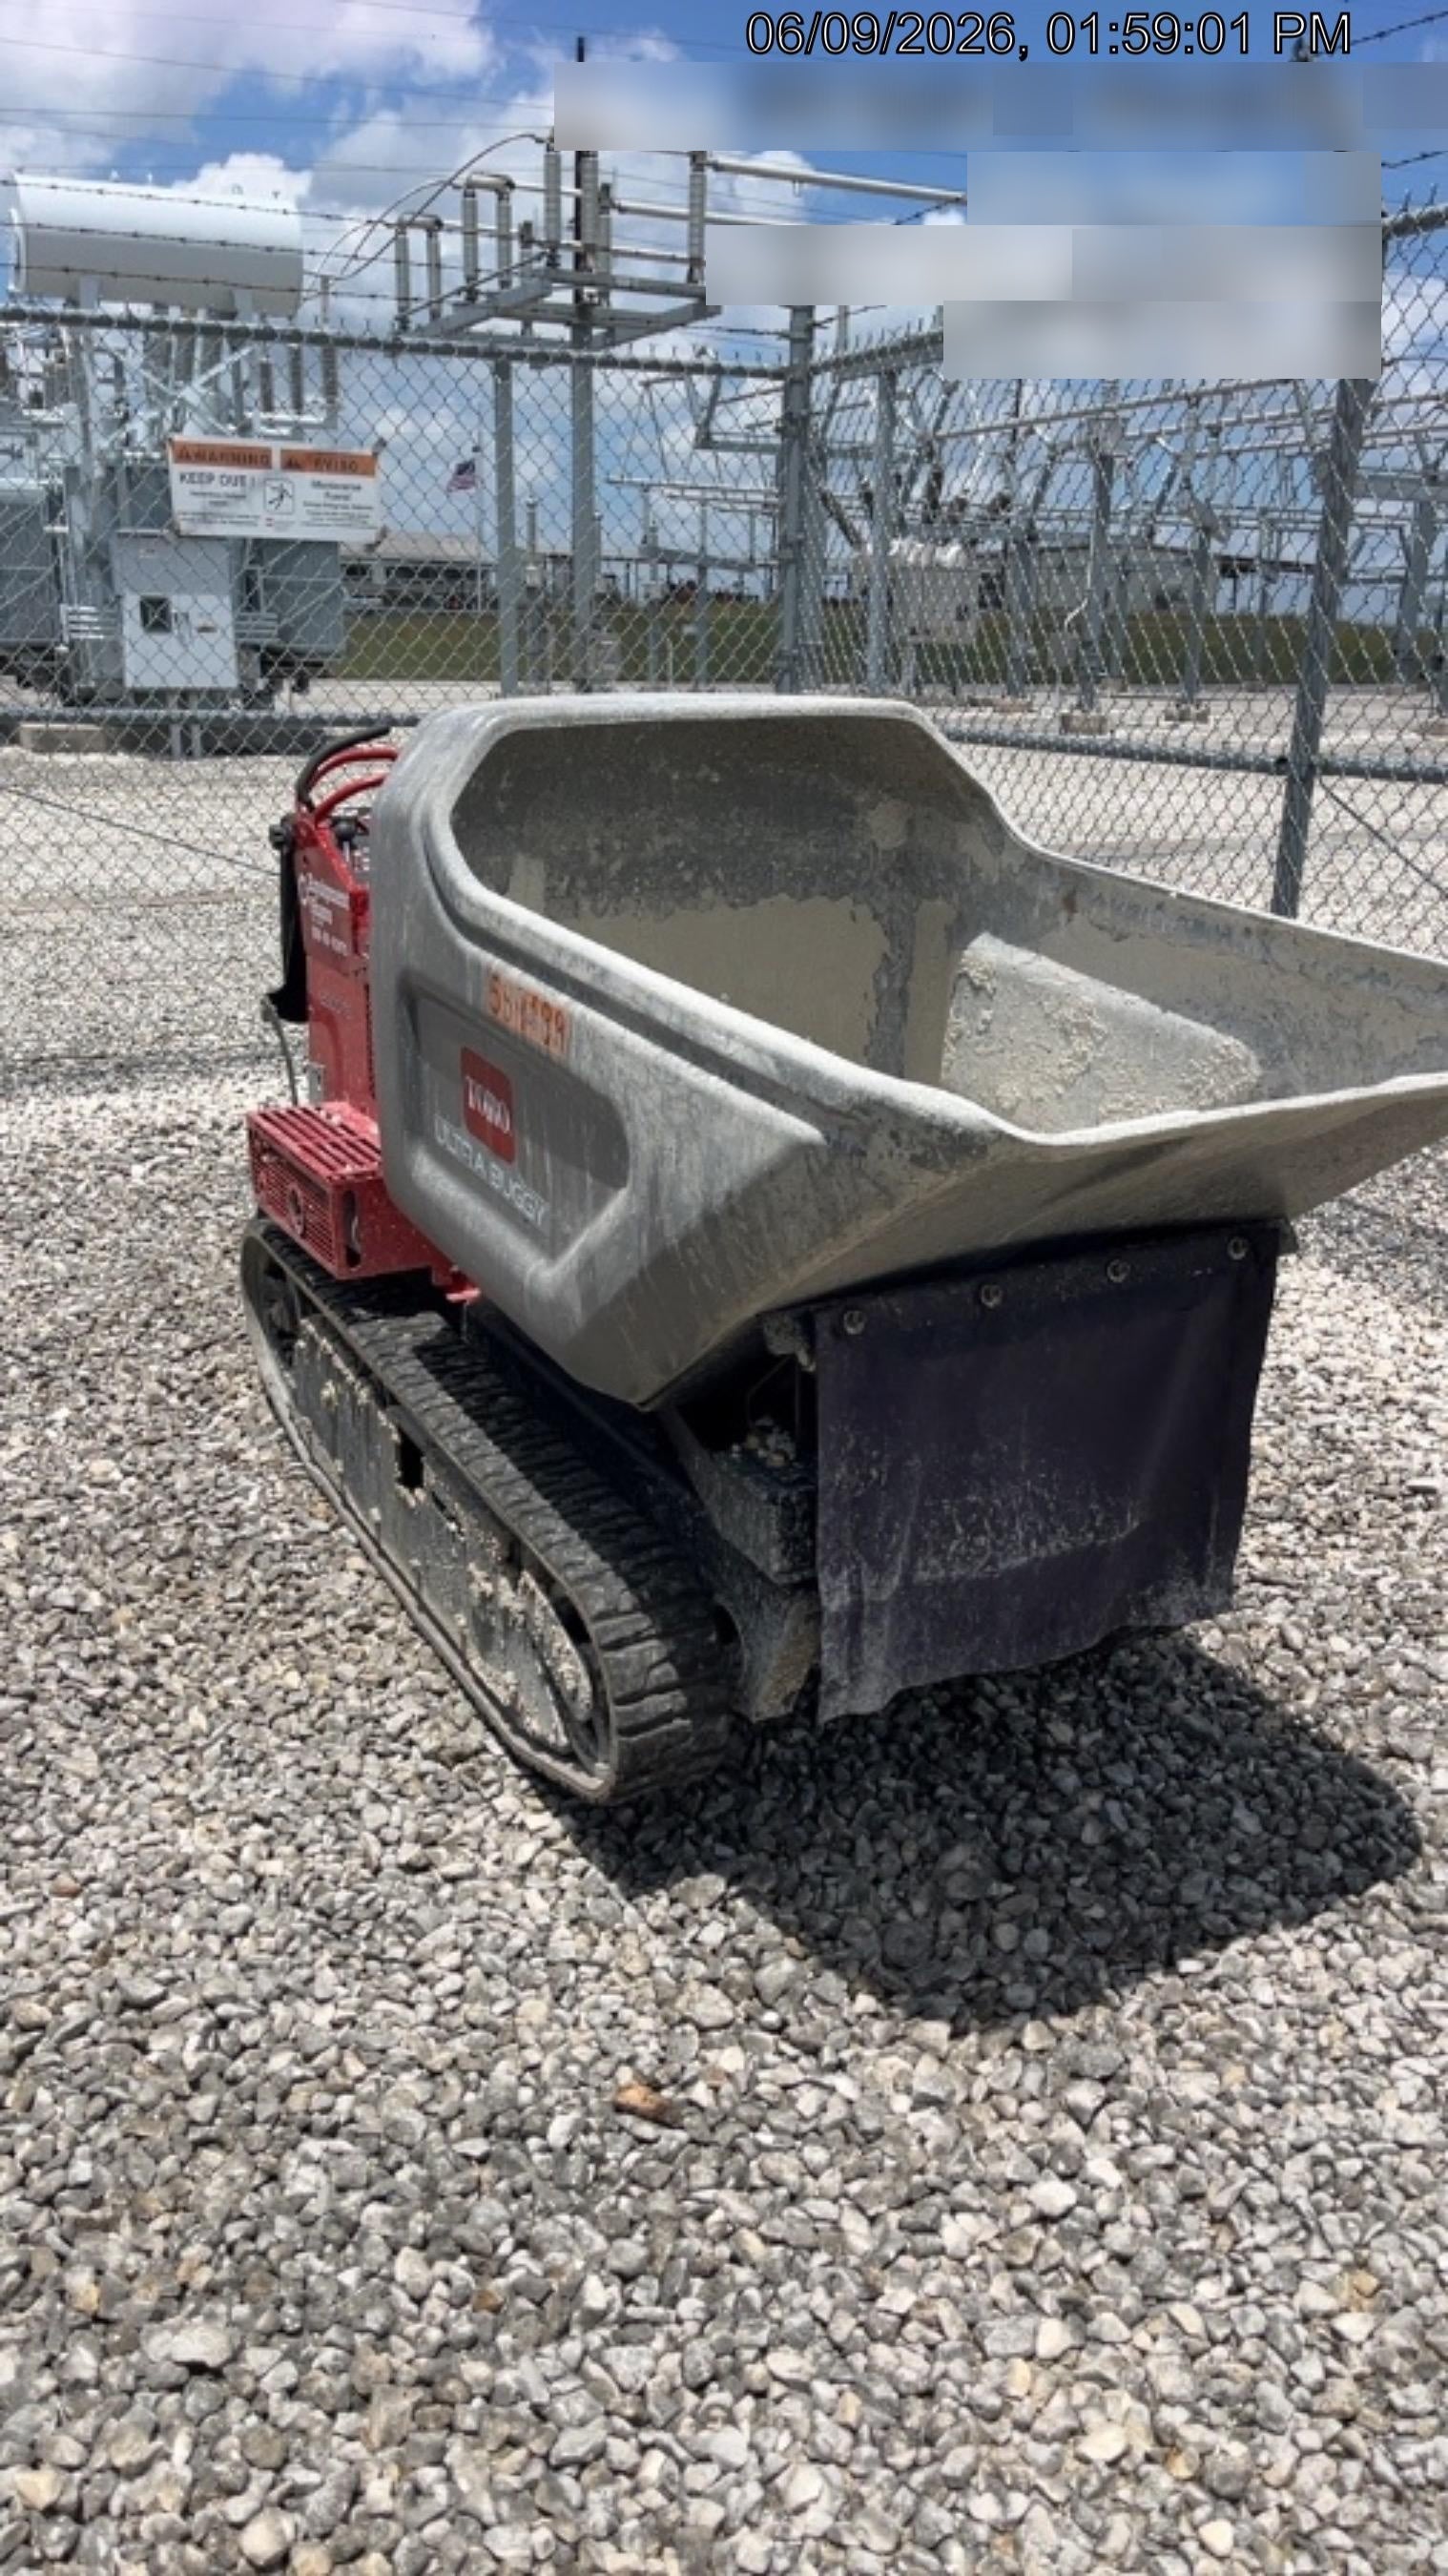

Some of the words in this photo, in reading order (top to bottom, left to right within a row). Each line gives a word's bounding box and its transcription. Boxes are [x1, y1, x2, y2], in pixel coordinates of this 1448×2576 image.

[193, 449, 270, 467] WARNING
[179, 471, 216, 485] KEEP
[465, 1074, 511, 1133] TORO
[434, 1113, 488, 1177] ULTRA
[489, 1167, 549, 1226] BUGGY
